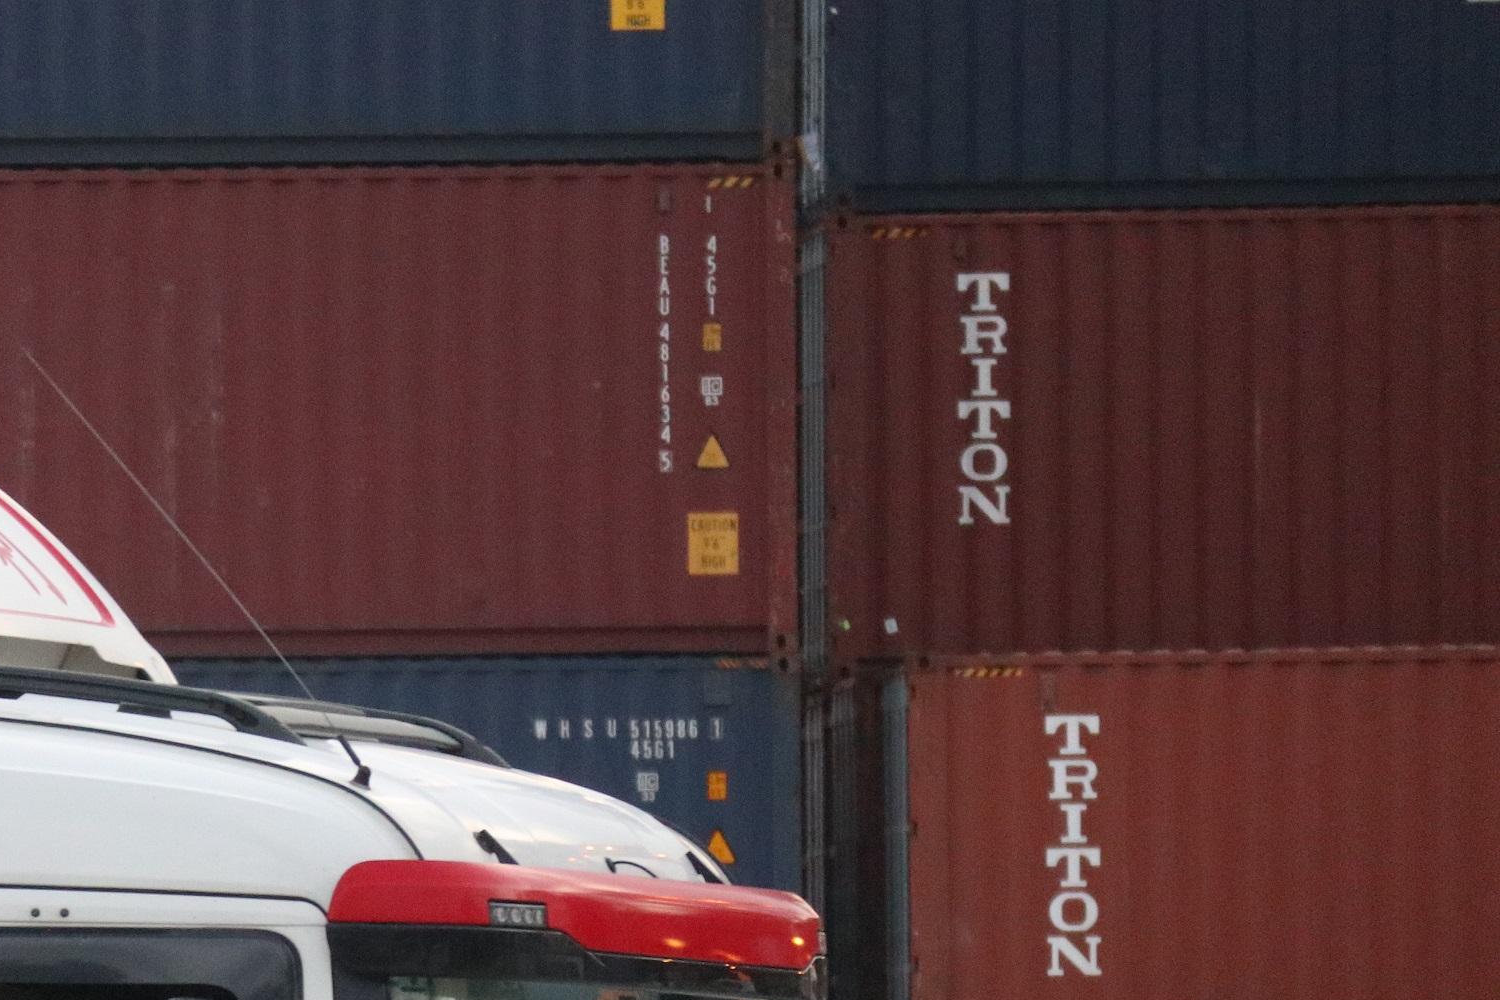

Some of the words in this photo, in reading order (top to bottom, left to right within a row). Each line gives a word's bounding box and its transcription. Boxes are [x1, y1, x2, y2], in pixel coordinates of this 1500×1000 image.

[658, 235, 671, 315] BEAU
[659, 323, 671, 443] 481634
[956, 272, 1011, 525] TRITON
[659, 451, 672, 472] 5
[534, 719, 617, 740] WHSU
[630, 719, 699, 740] 515986
[1043, 714, 1102, 977] TRITON
